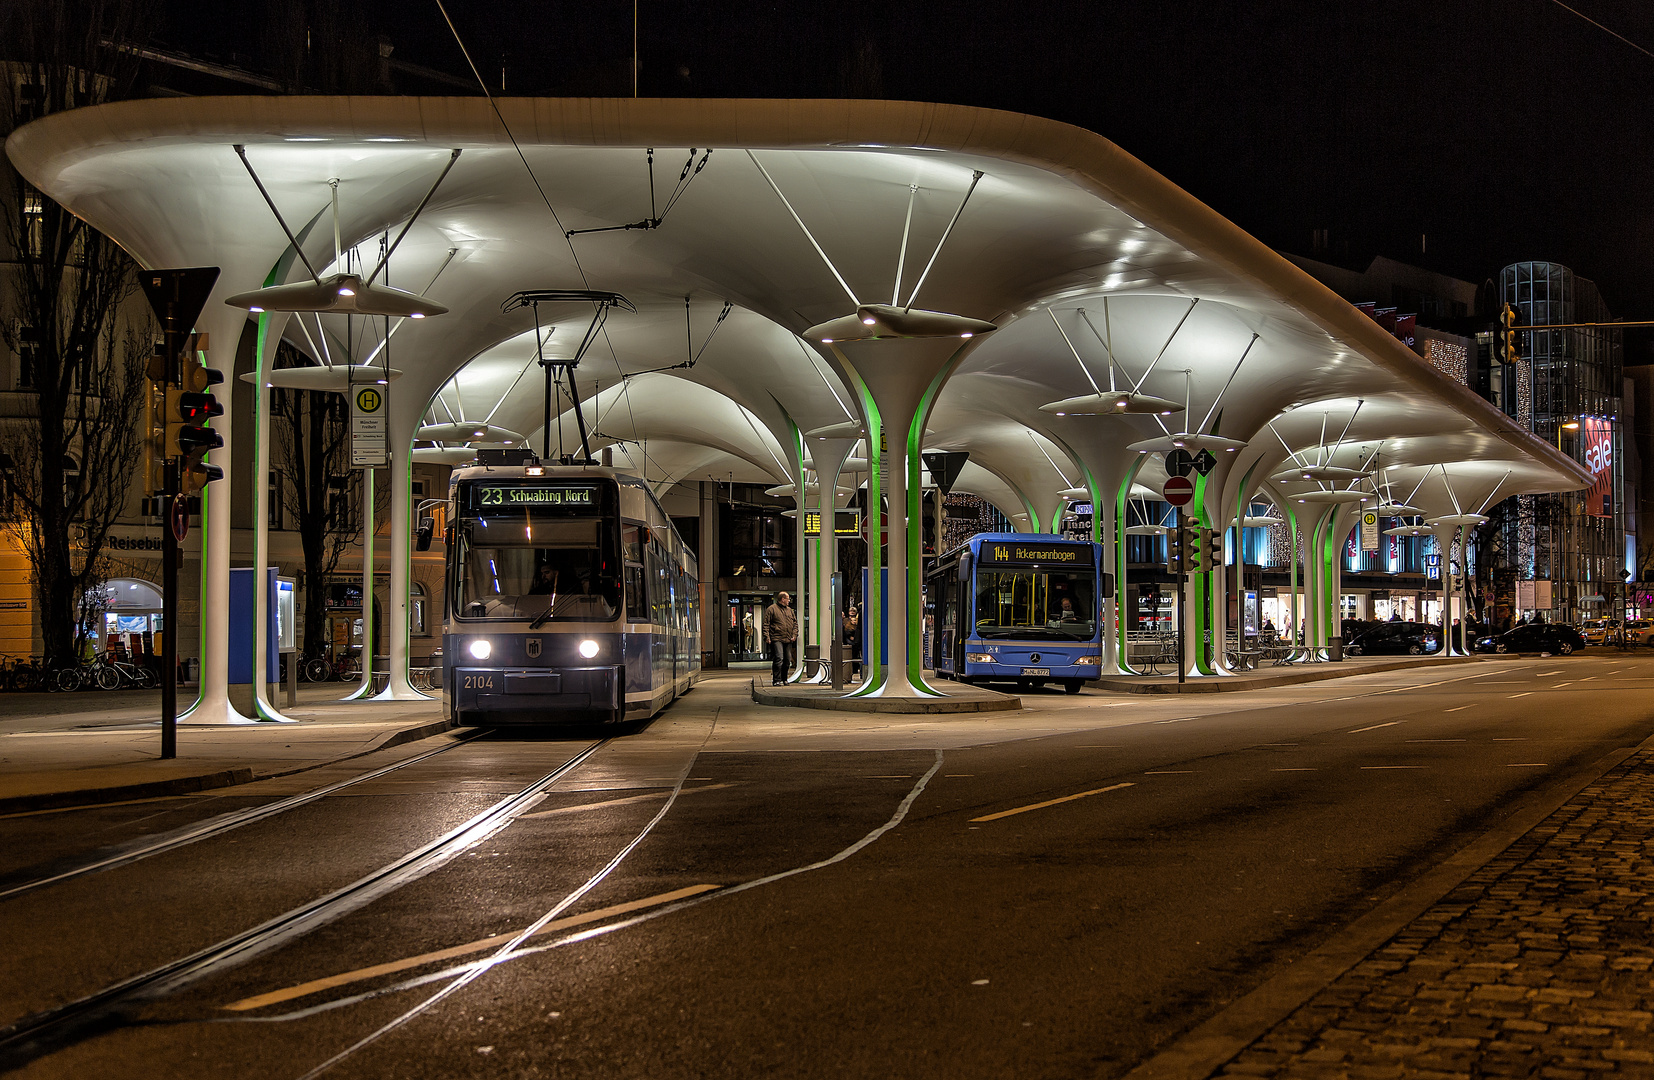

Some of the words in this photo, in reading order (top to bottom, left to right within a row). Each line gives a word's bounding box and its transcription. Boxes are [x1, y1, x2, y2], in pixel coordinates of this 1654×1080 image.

[1585, 436, 1612, 475] sale
[481, 488, 503, 505] 23
[509, 489, 561, 505] Schwabing
[565, 489, 589, 502] Nord
[109, 535, 164, 550] Reisebü
[994, 546, 1009, 561] 144
[1015, 547, 1076, 561] Ackermannbogen
[1428, 555, 1438, 566] U
[464, 676, 493, 689] 2104
